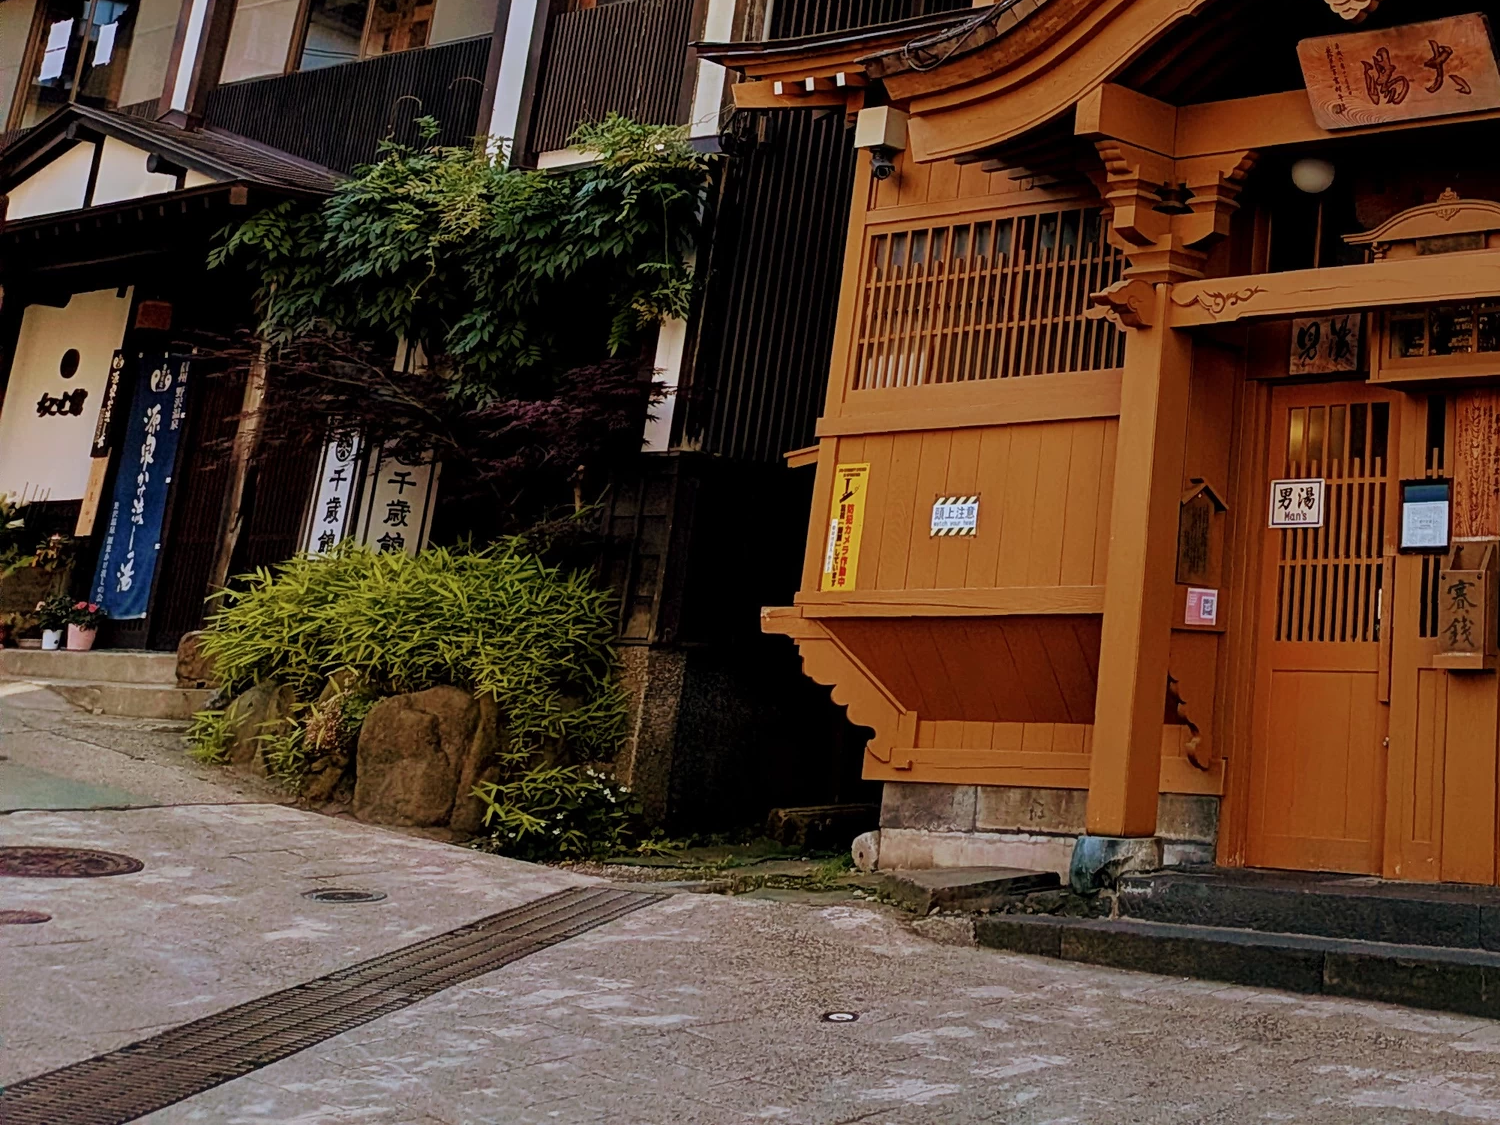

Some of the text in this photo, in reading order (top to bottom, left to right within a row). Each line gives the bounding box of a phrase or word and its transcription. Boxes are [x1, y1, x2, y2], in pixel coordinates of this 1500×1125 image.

[1278, 486, 1315, 510] 男湯
[318, 468, 347, 554] 千歳館
[377, 471, 416, 556] 千歳館
[934, 506, 975, 521] 頭上注意
[1284, 510, 1307, 521] Man's
